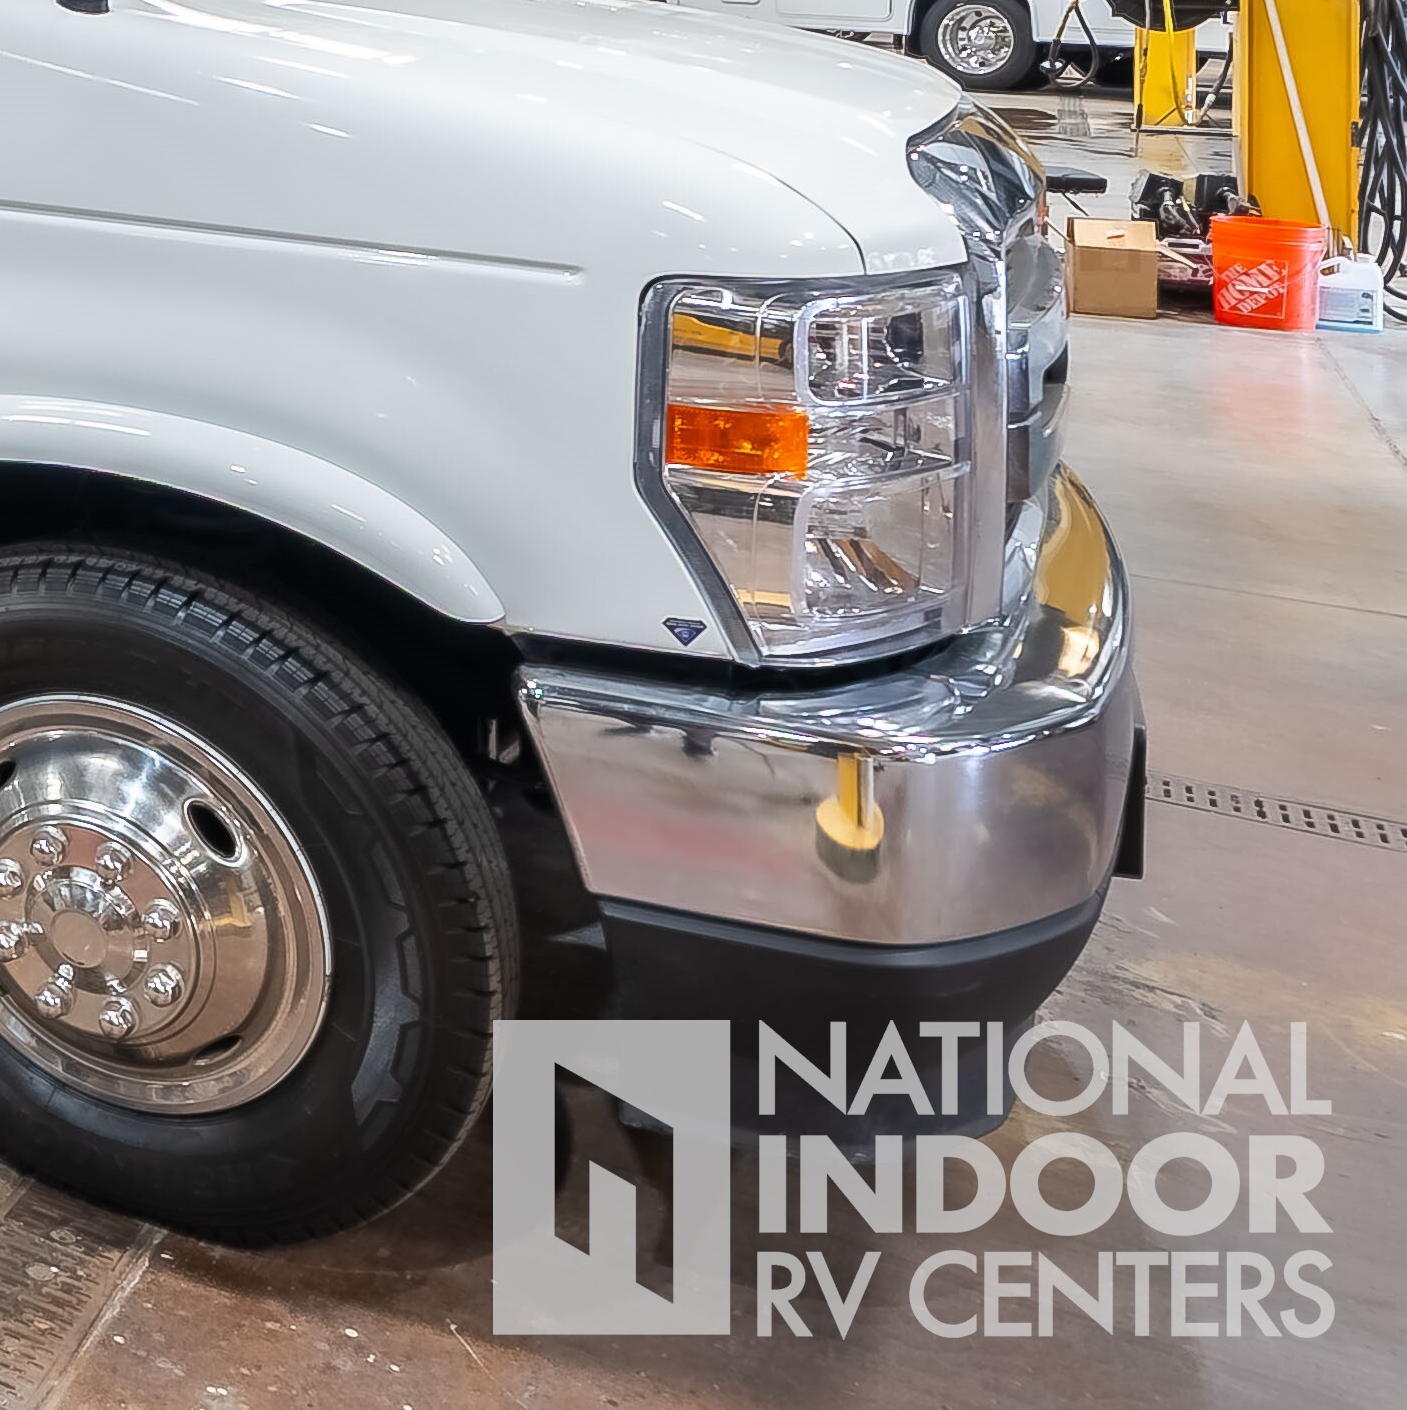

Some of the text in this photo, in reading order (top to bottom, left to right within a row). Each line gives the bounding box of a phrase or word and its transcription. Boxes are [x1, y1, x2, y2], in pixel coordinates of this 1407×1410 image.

[1217, 259, 1286, 311] HOME
[1221, 262, 1247, 283] THE
[1236, 281, 1286, 314] DEPOT
